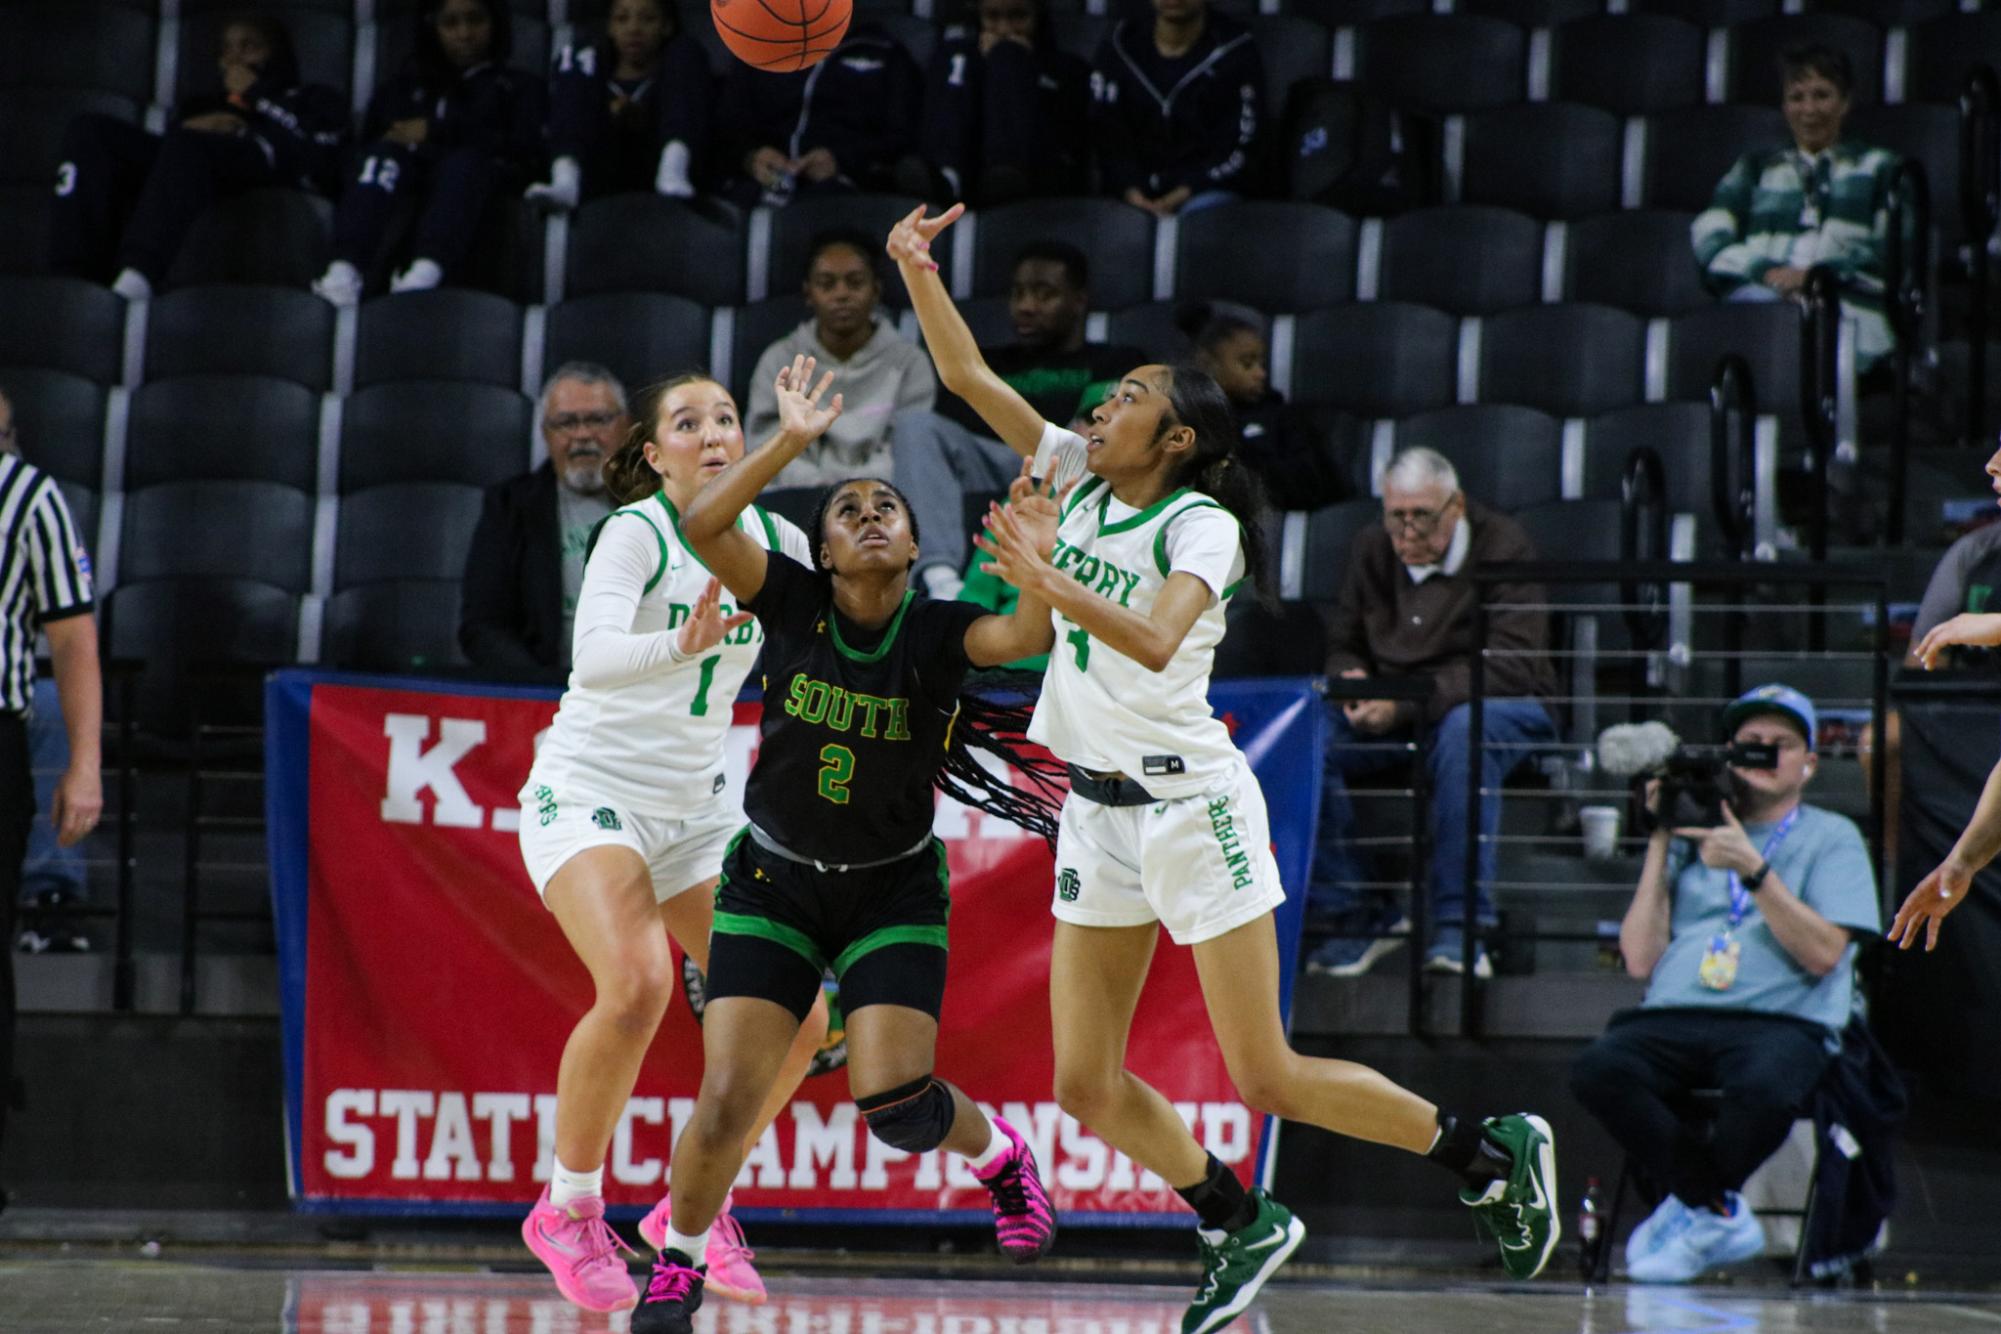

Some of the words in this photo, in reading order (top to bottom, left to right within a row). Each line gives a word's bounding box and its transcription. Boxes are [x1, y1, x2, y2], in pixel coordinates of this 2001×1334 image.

[55, 160, 78, 197] 3
[690, 654, 721, 717] 1
[784, 673, 911, 740] SOUTH
[818, 743, 856, 804] 2
[1170, 760, 1180, 769] M
